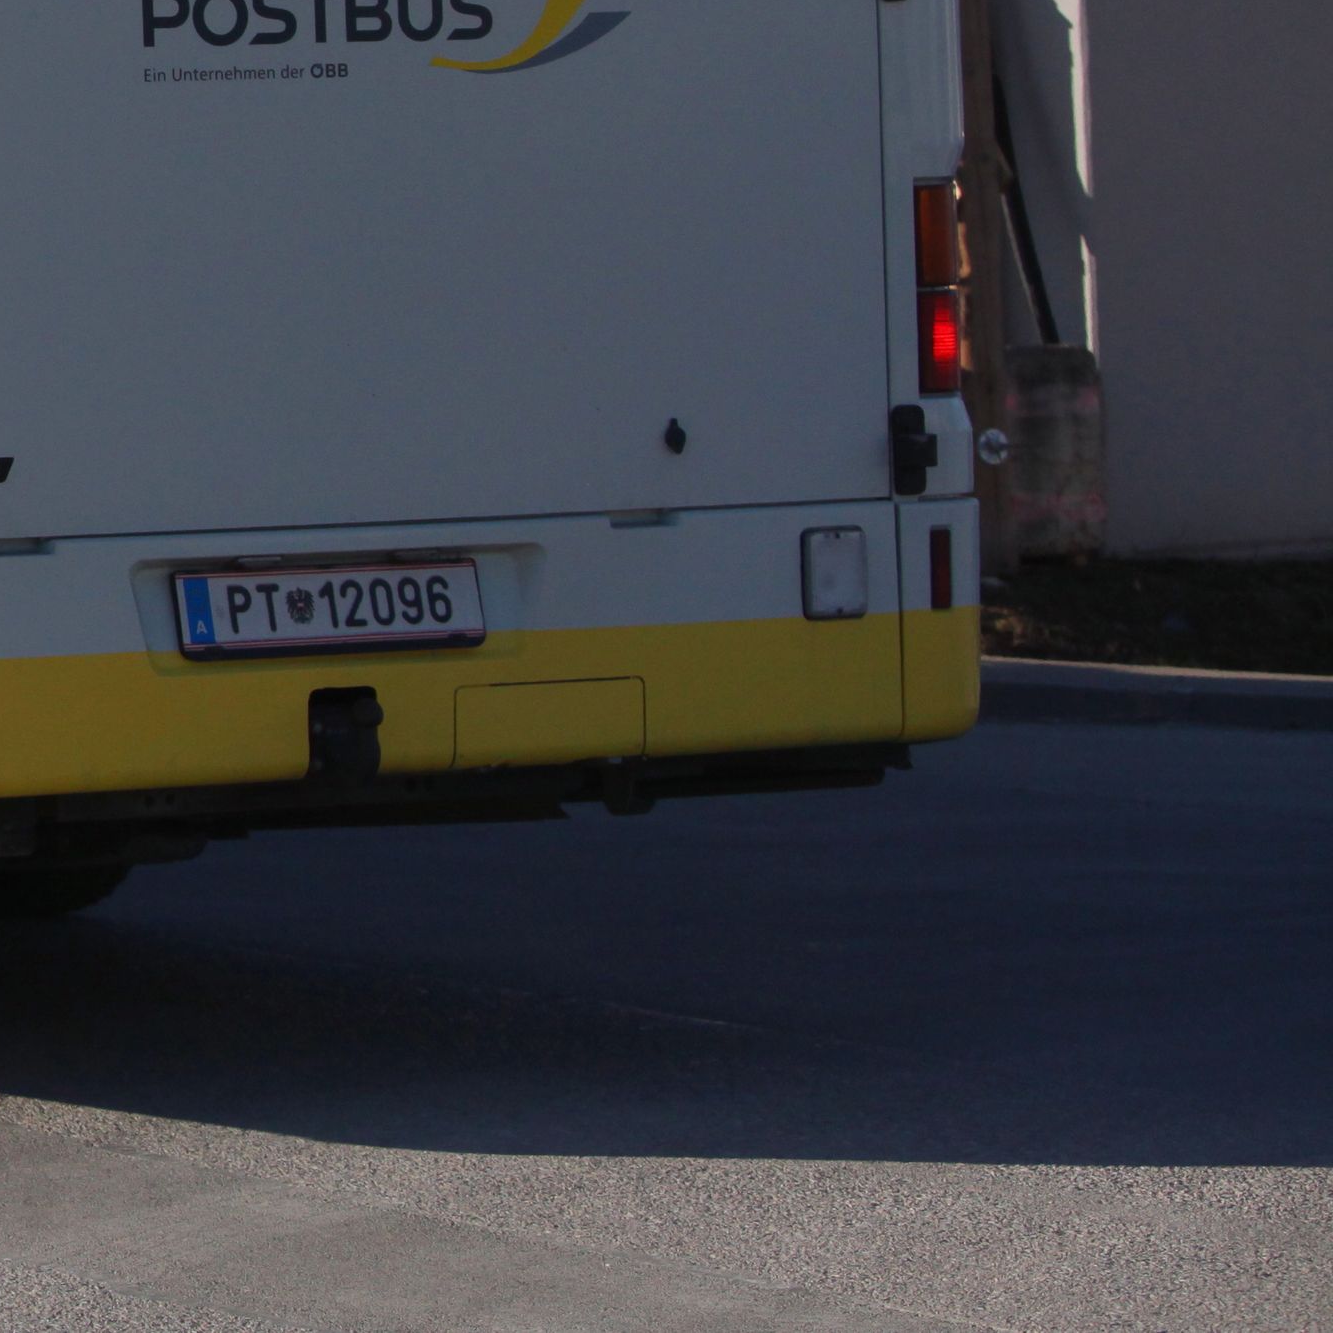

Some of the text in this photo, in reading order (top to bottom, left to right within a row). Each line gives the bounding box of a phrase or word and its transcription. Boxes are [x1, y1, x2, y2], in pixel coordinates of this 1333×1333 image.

[143, 61, 349, 83] Ein Unternehmen der ÖBB
[196, 574, 453, 635] A PT 12096
